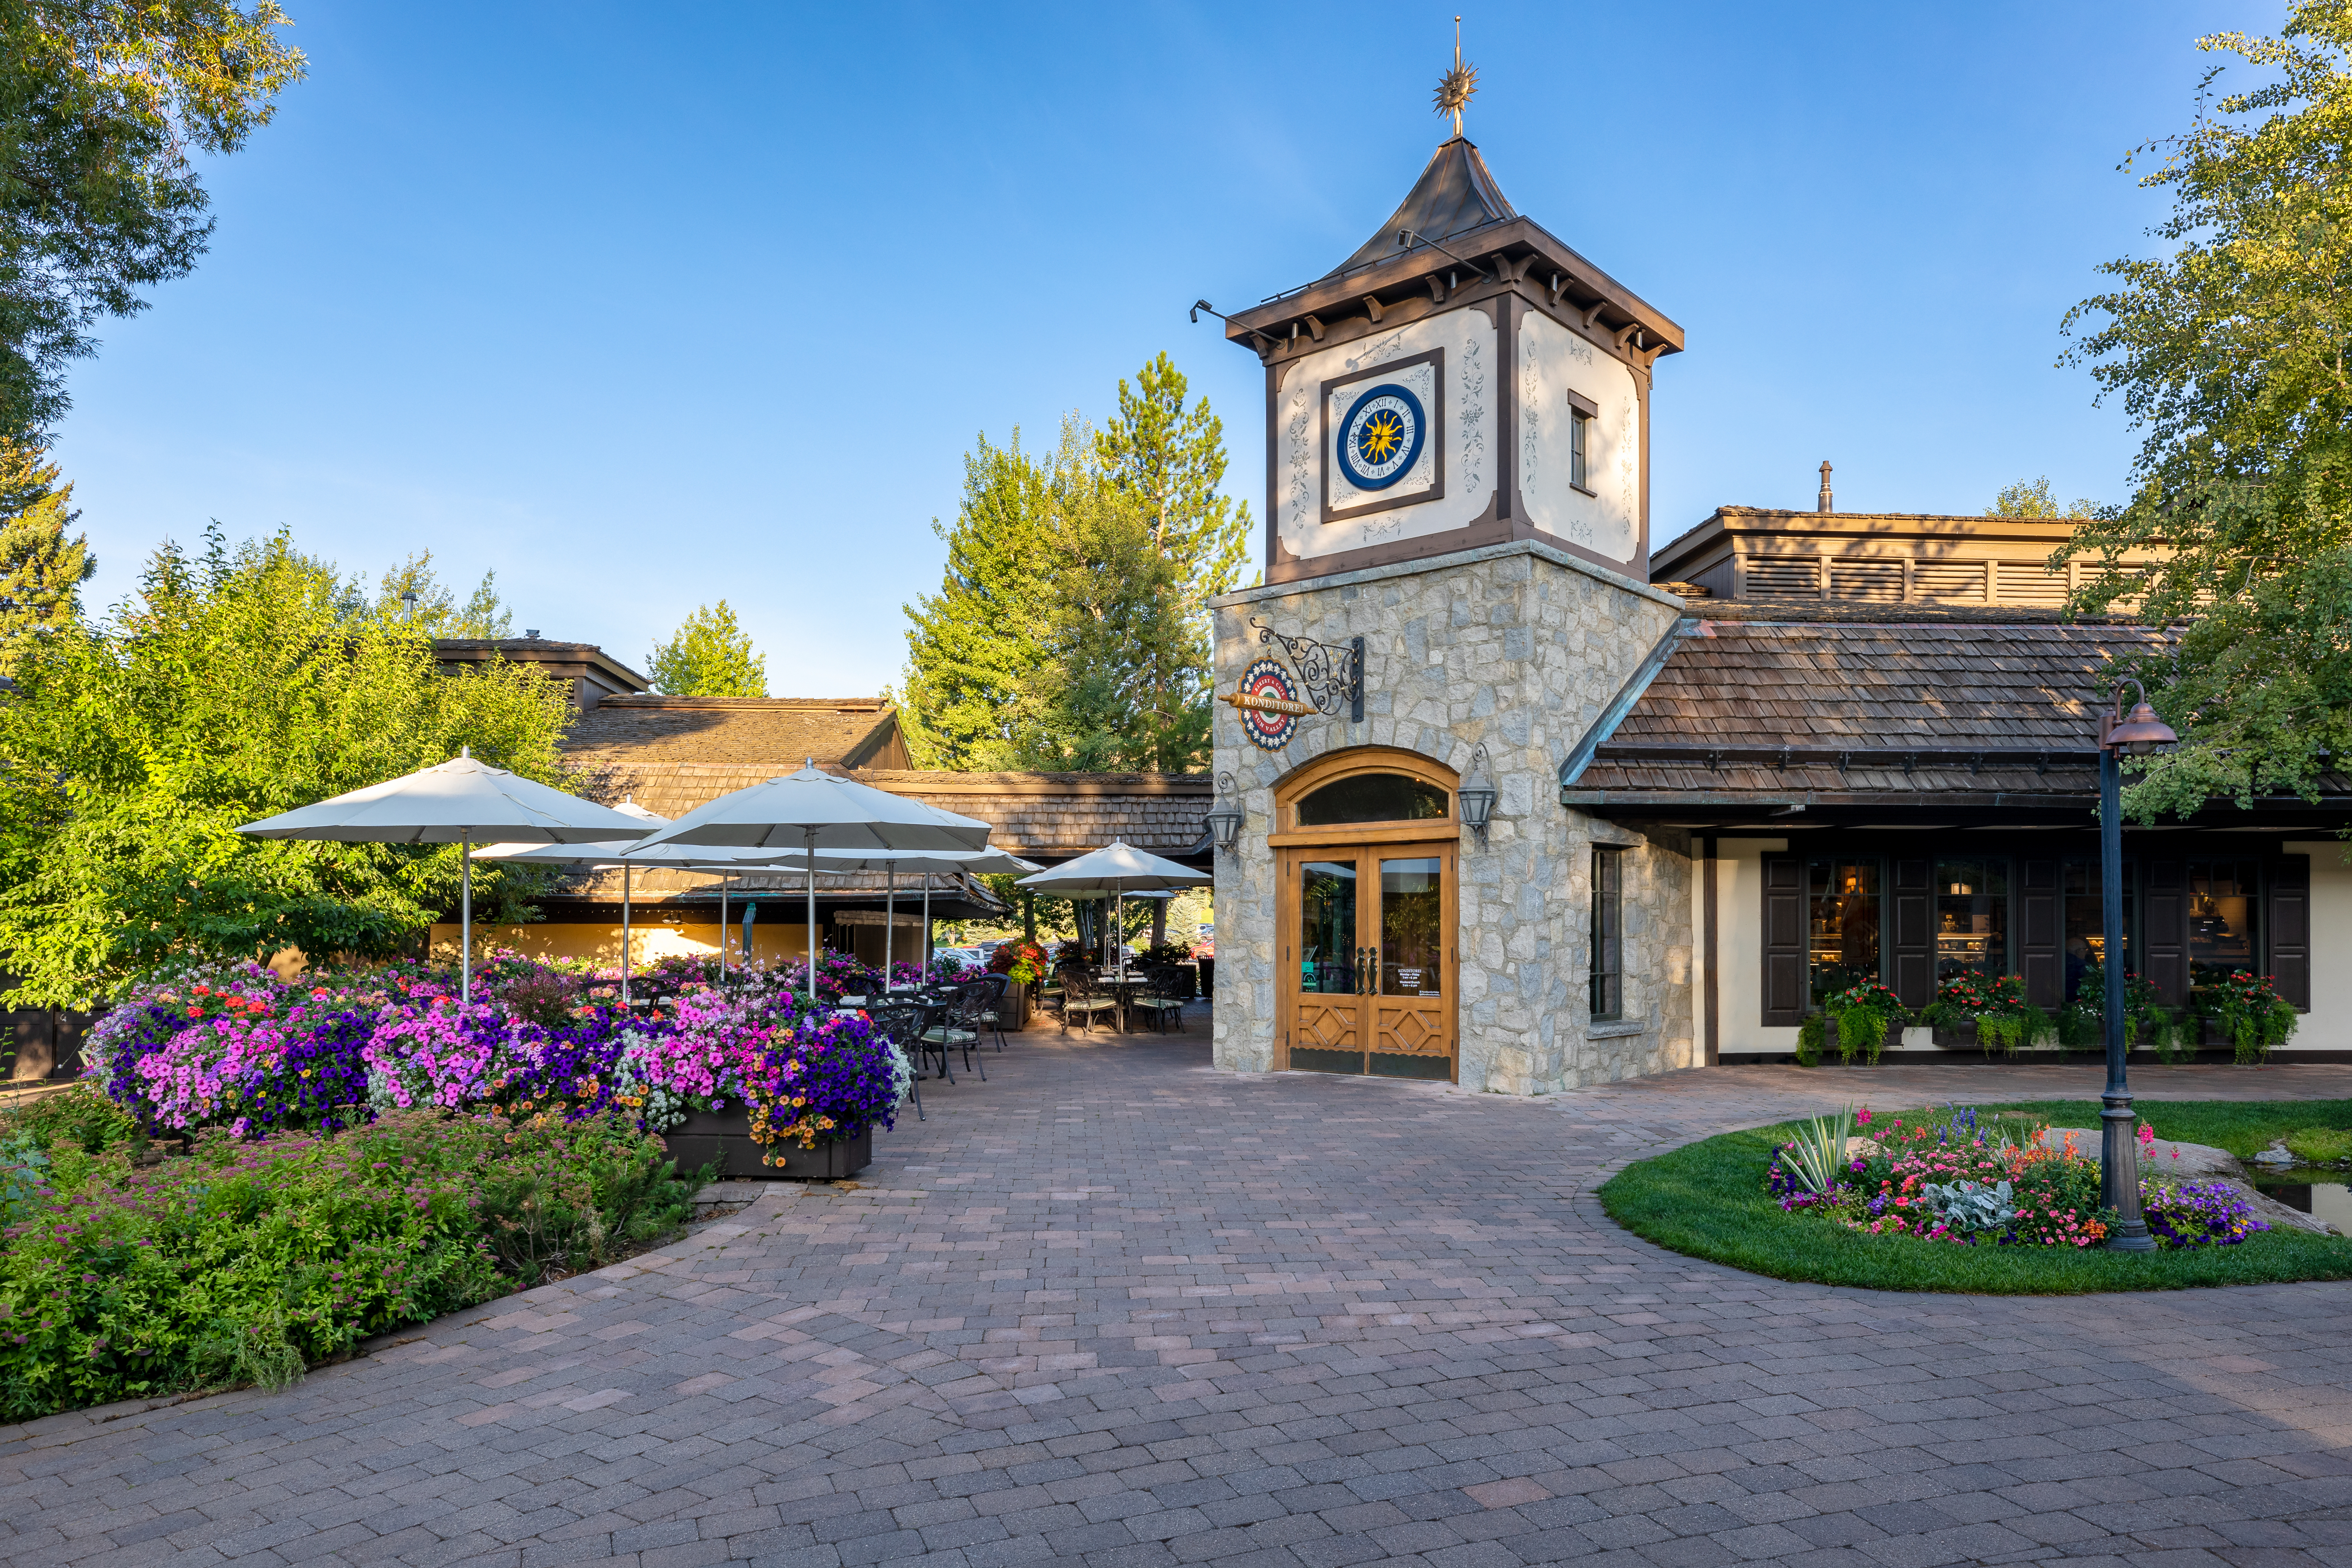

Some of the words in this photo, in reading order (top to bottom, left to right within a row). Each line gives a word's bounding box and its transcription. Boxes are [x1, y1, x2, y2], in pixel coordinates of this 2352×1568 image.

[1375, 398, 1386, 409] XII
[1394, 400, 1398, 408] I
[1363, 405, 1372, 417] XI
[1402, 409, 1410, 418] II
[1353, 421, 1361, 430] X
[1349, 439, 1356, 449] IX
[1402, 445, 1410, 456] IV
[1351, 452, 1360, 468] VIII
[1392, 460, 1398, 469] V
[1360, 464, 1370, 476] VII
[1378, 466, 1385, 477] VI
[1254, 679, 1270, 692] BAKERY
[1276, 682, 1285, 696] CAFE
[1243, 696, 1303, 713] KONDITOREI
[1254, 714, 1264, 728] SUN
[1265, 717, 1285, 732] VALLEY
